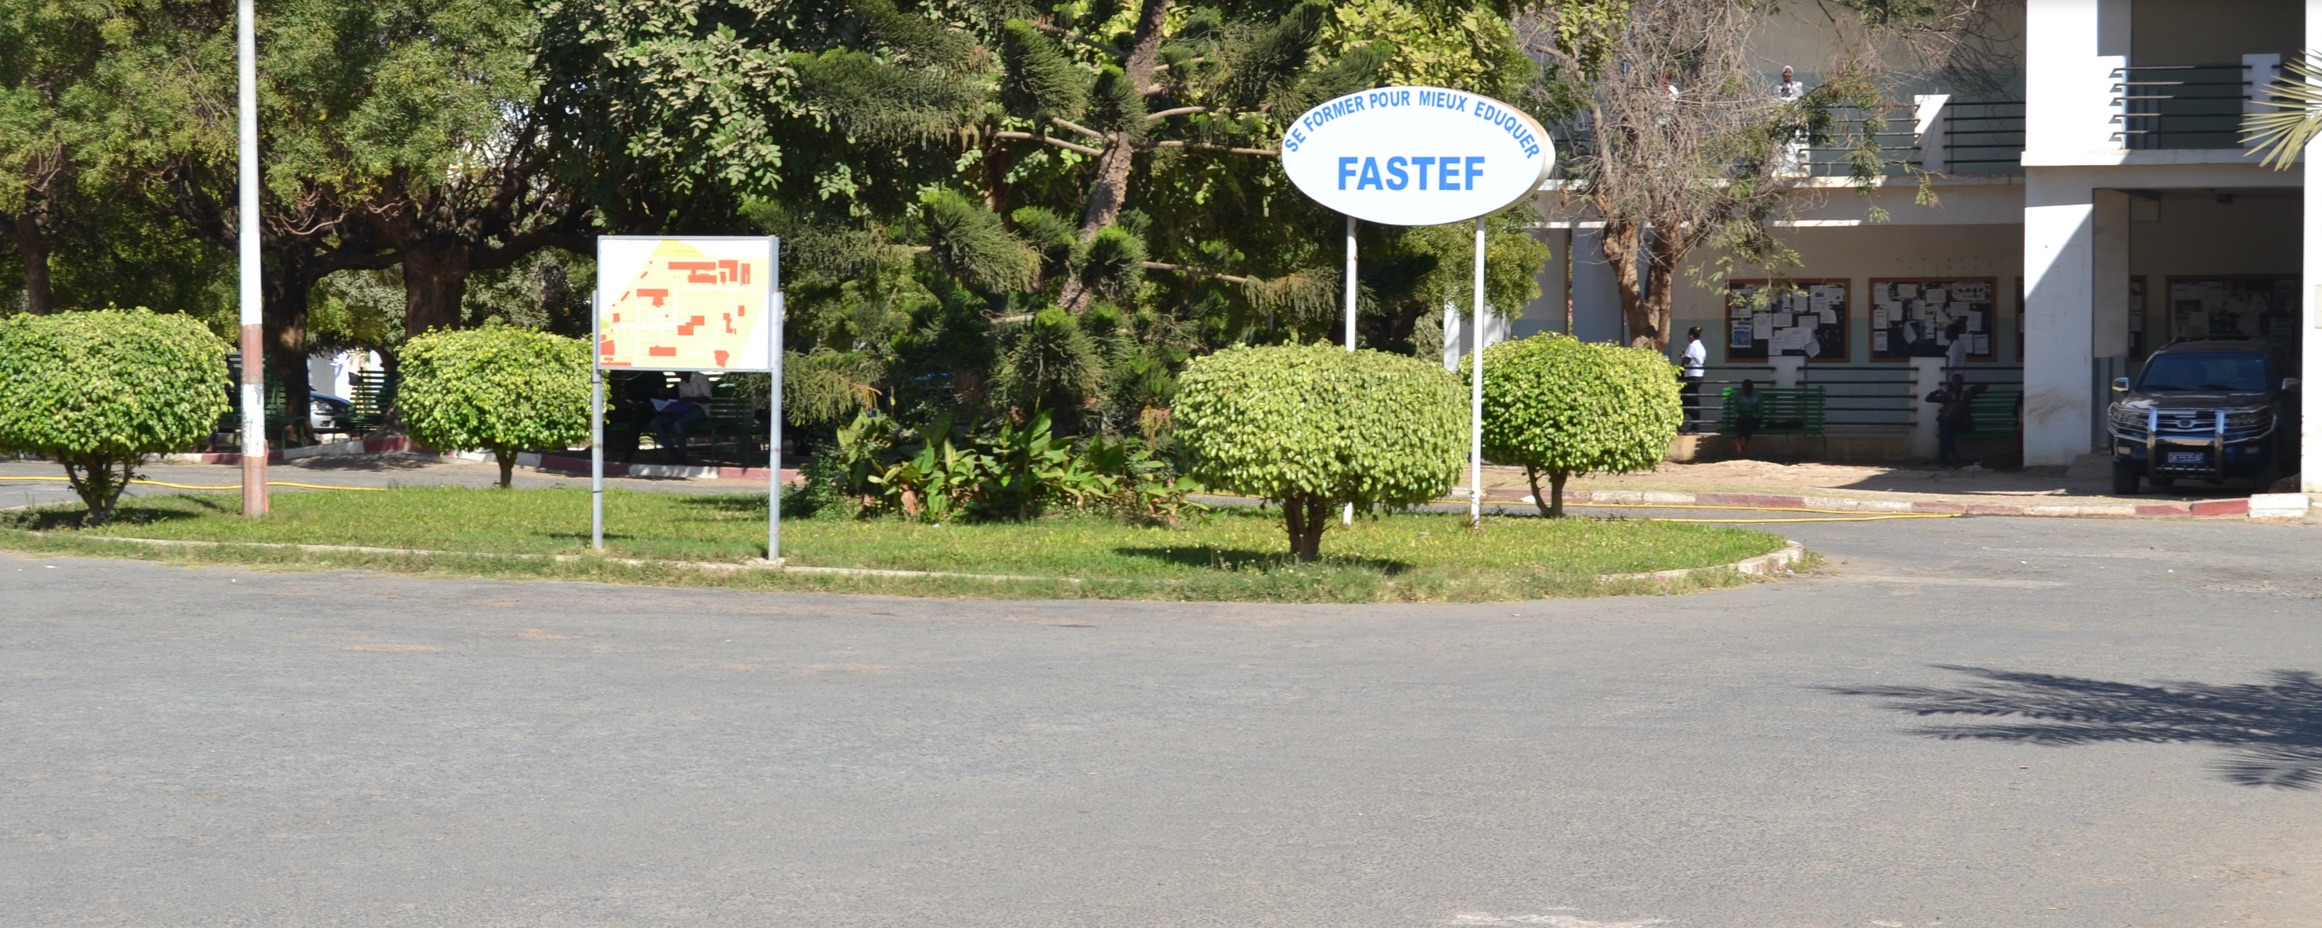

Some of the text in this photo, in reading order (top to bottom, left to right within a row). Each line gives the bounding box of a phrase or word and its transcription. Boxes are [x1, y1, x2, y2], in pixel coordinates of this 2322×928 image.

[1284, 91, 1540, 159] SE FORMER POUR MIEUX EDUQUER
[1338, 156, 1486, 191] FASTEF
